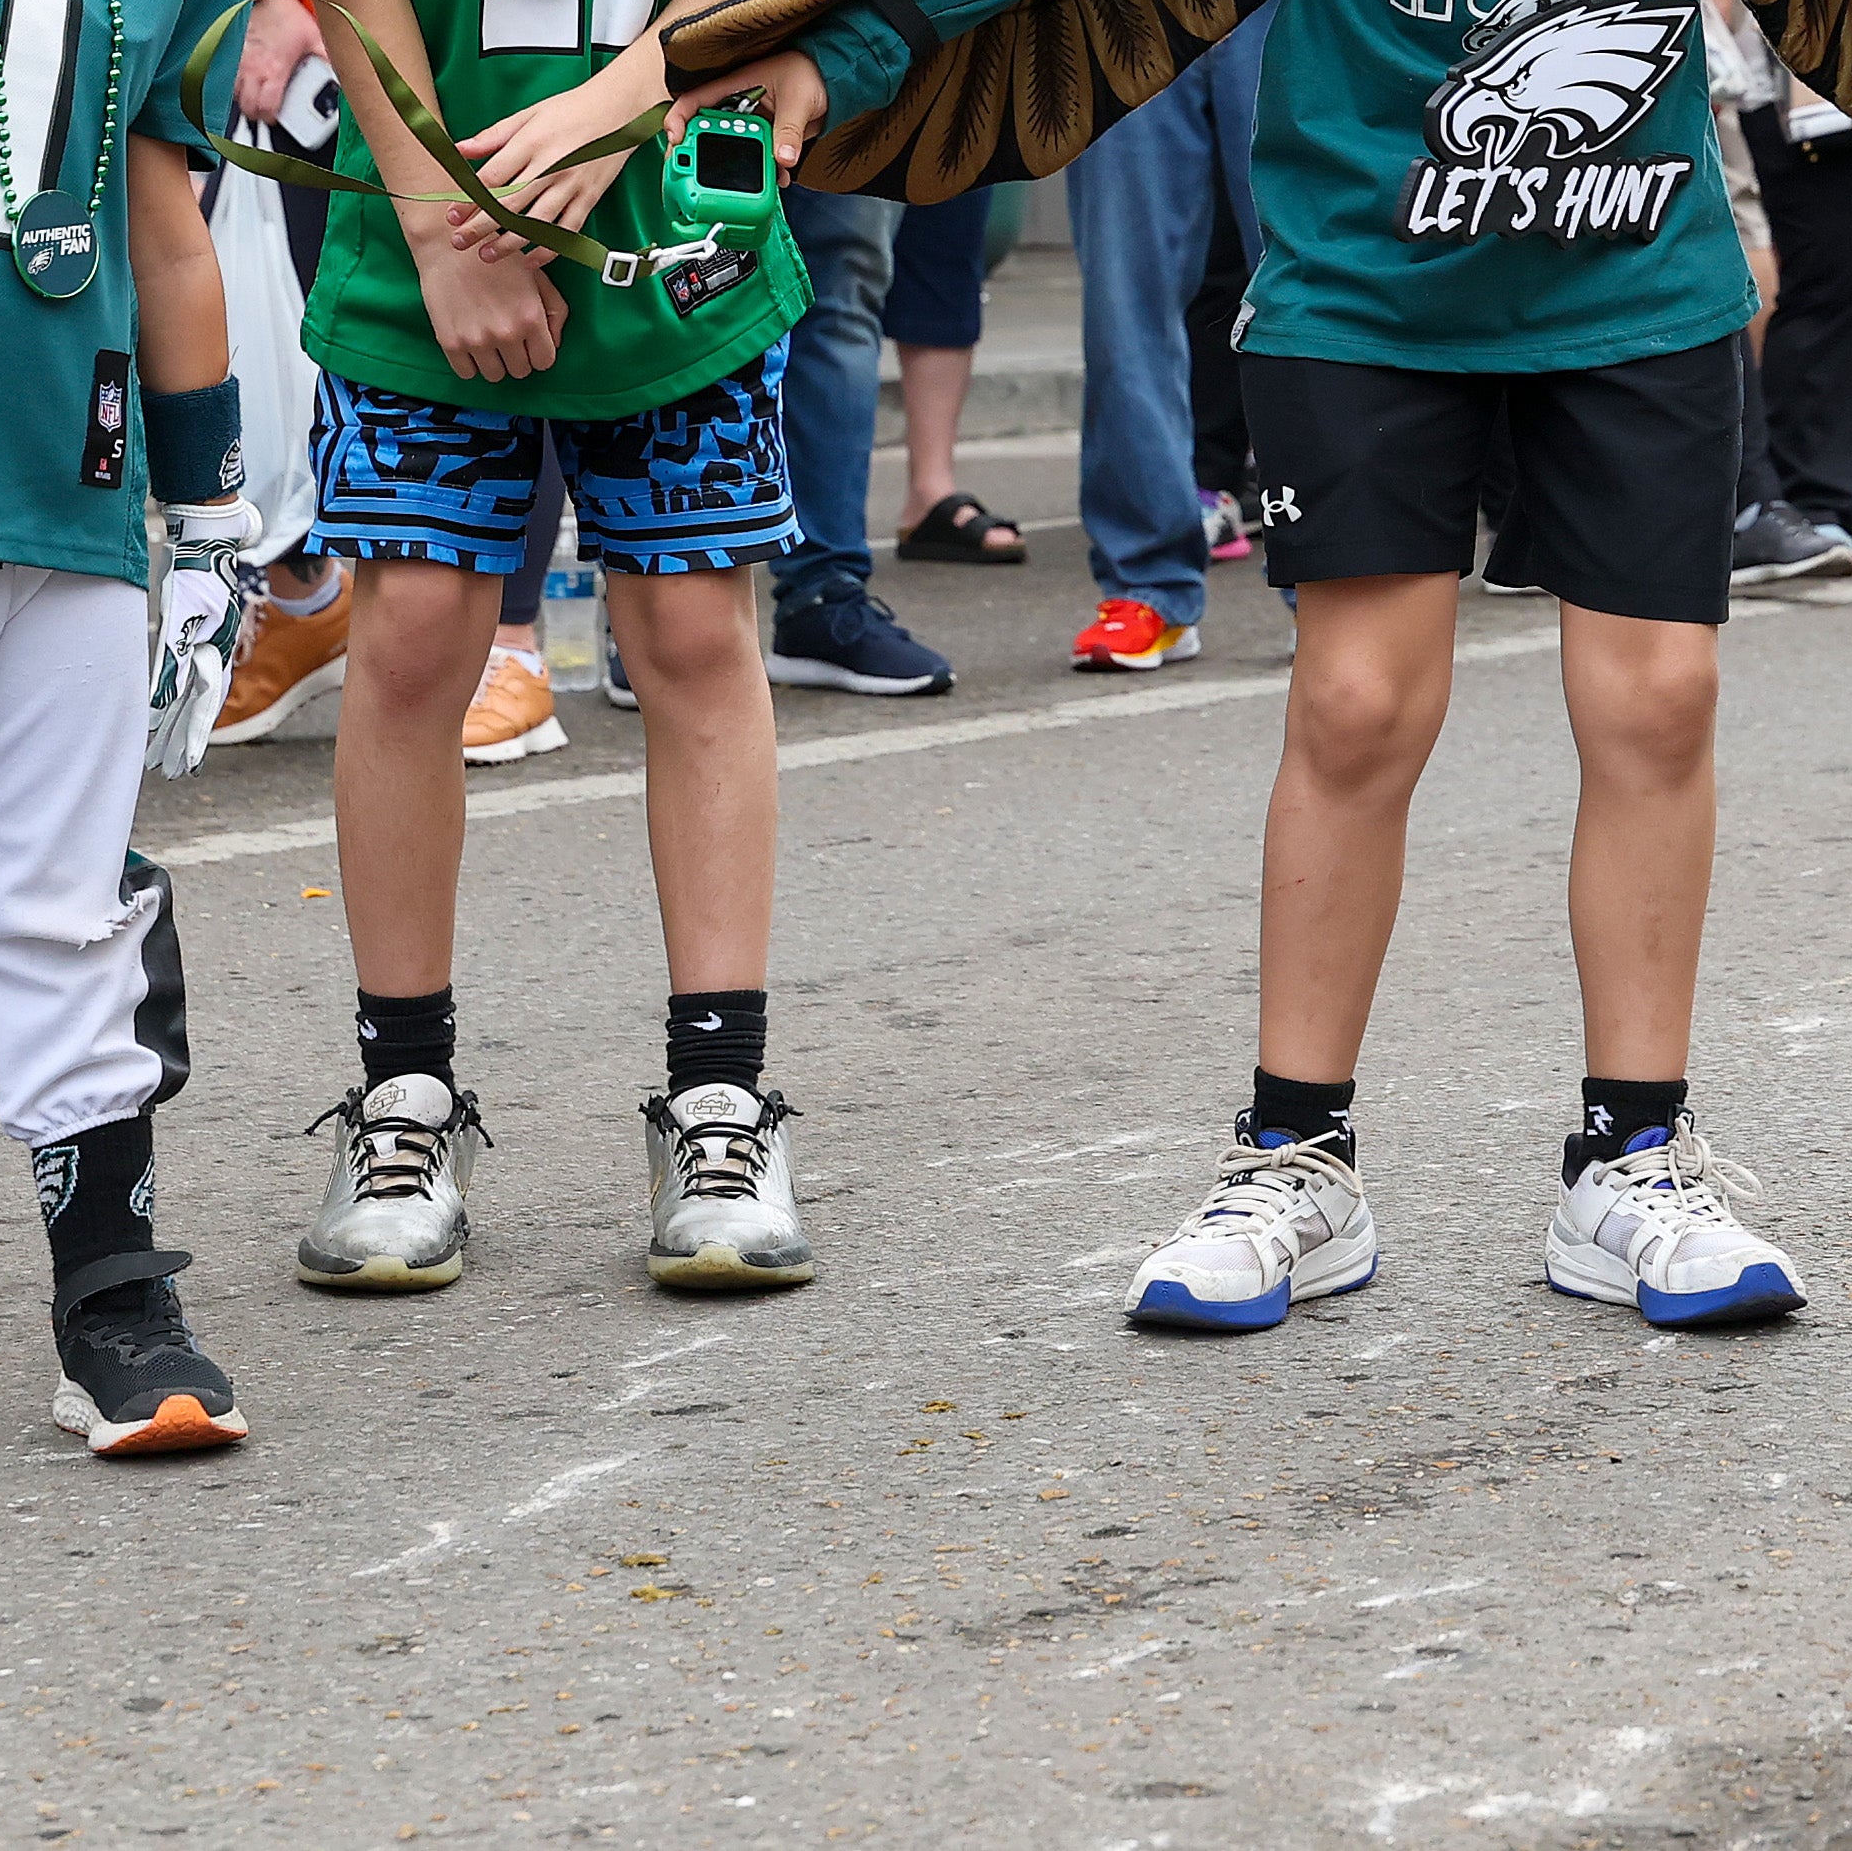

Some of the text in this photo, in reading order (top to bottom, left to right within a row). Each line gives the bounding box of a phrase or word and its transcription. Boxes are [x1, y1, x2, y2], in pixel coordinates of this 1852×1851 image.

[1408, 162, 1690, 239] LET'S HUNT
[21, 223, 91, 245] AUTHENTIC
[60, 236, 91, 256] FAN
[101, 404, 119, 423] NFL
[111, 438, 124, 458] S
